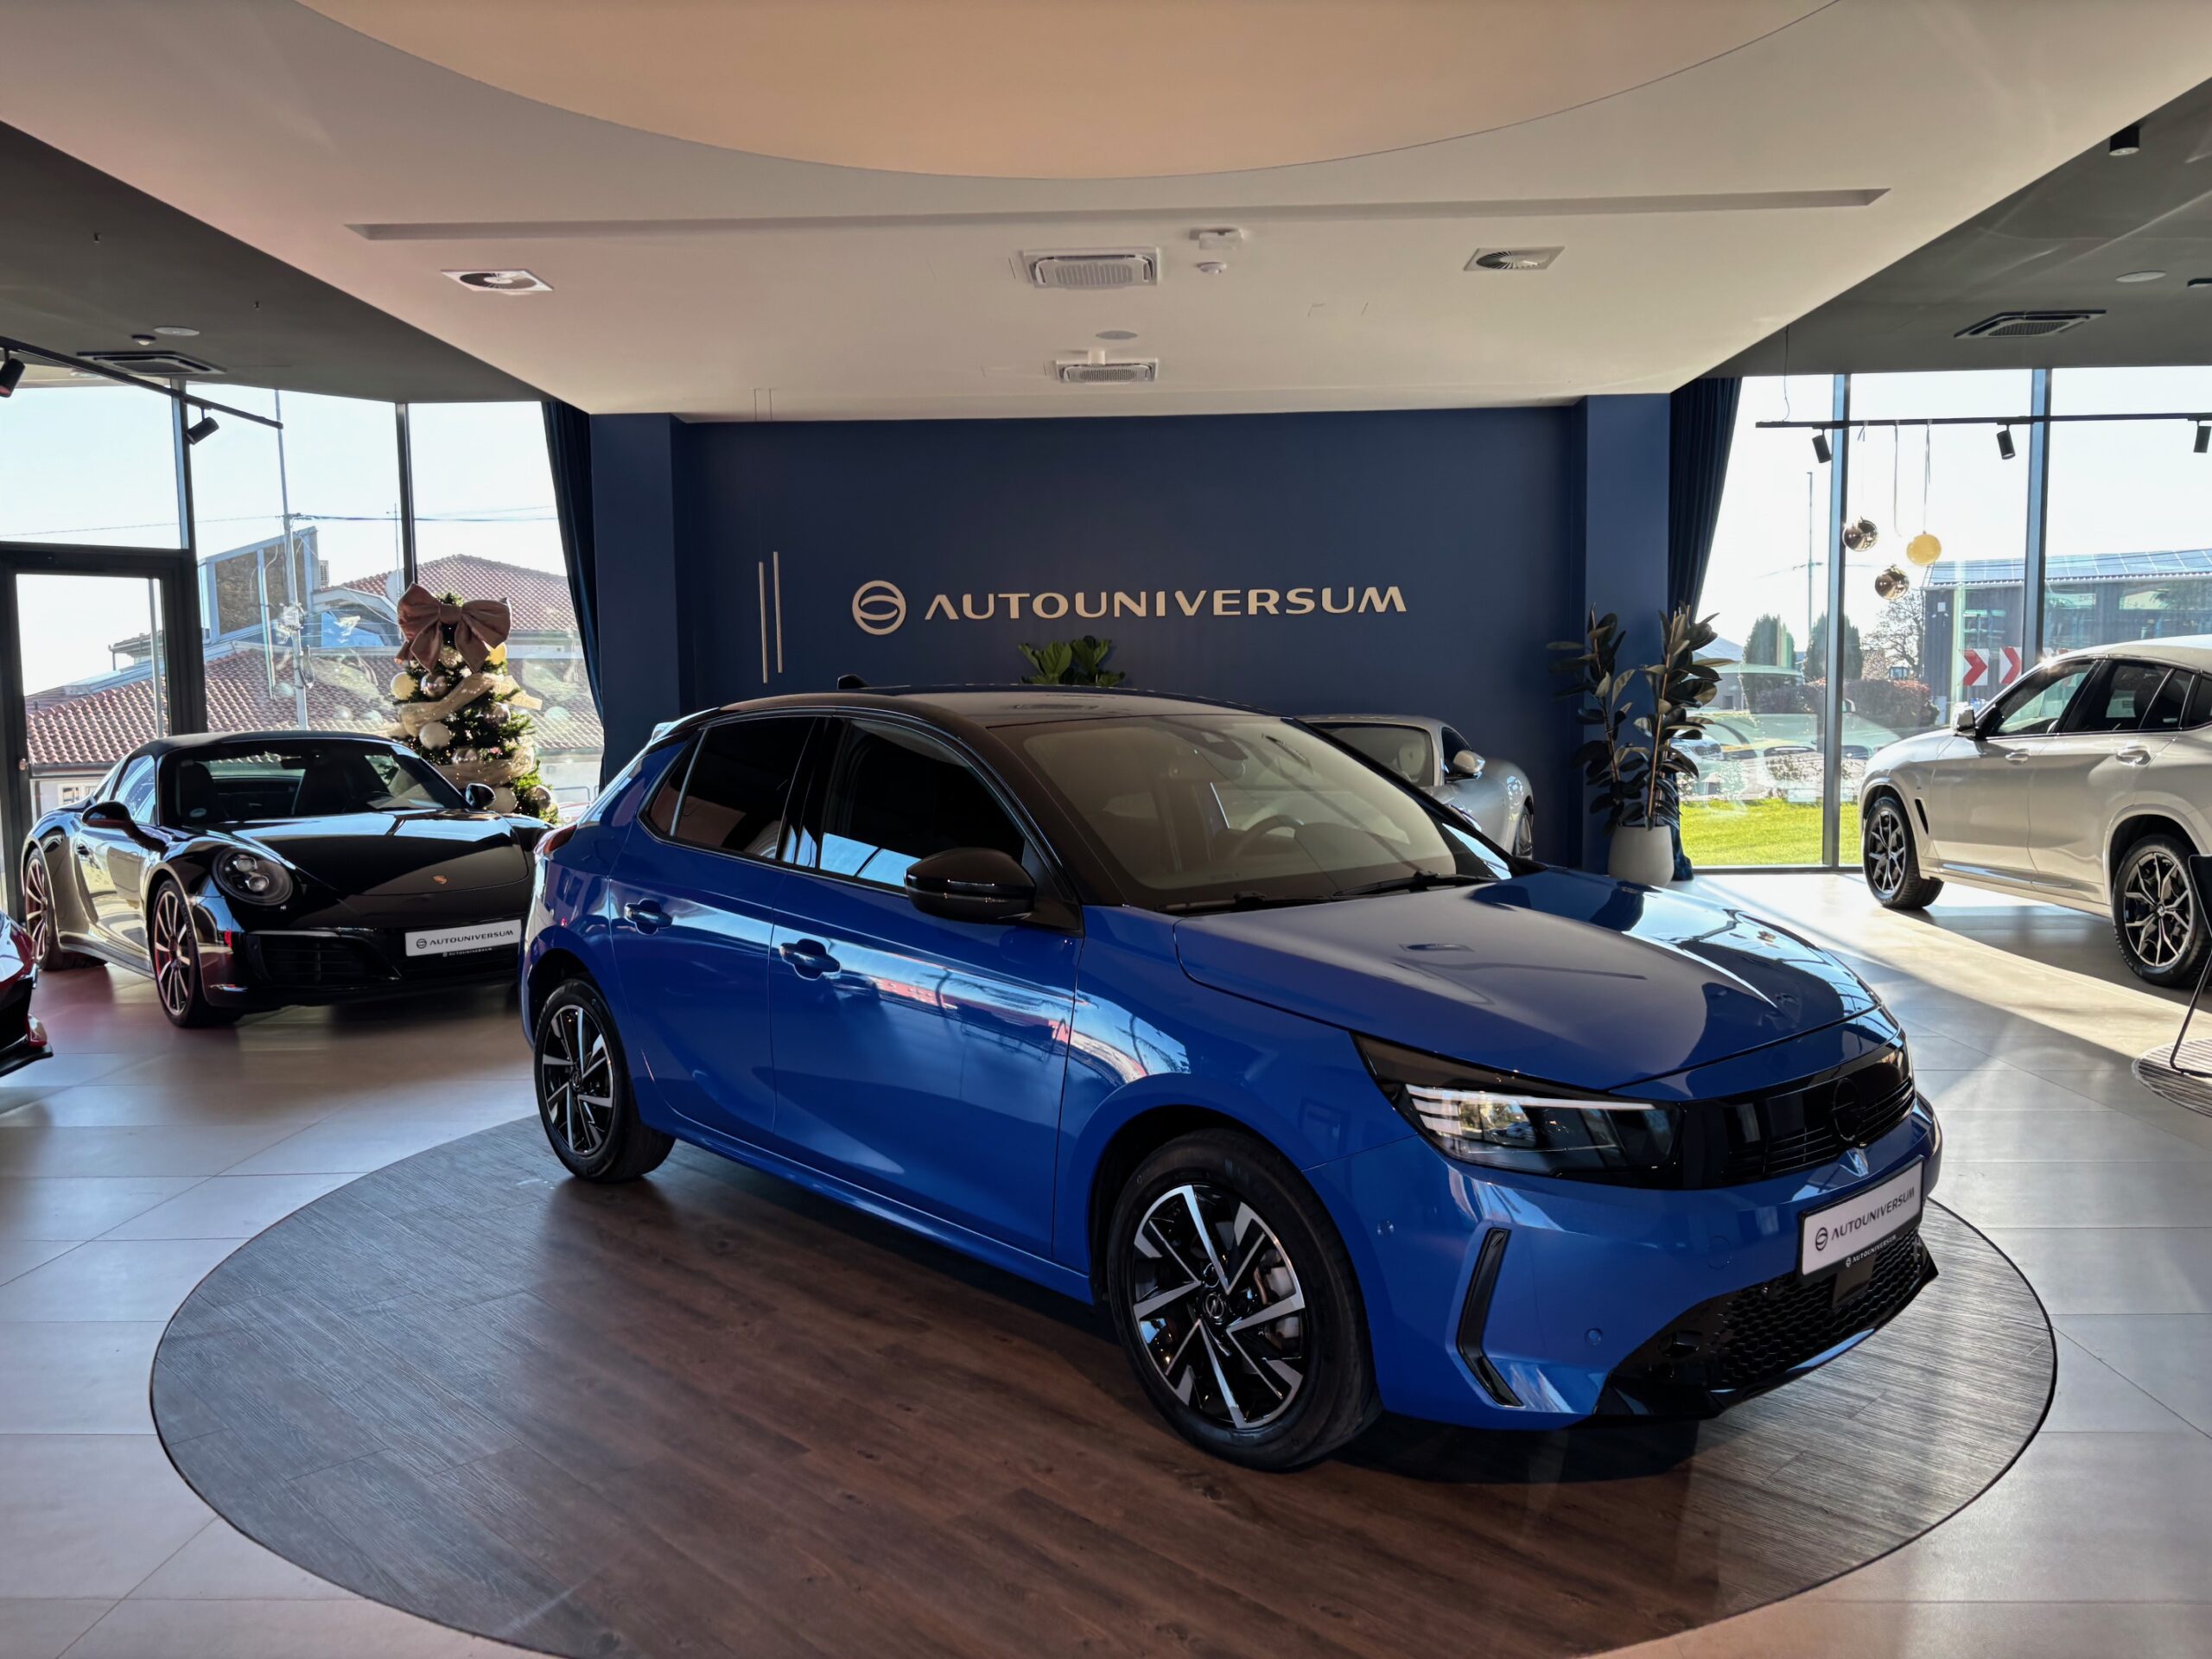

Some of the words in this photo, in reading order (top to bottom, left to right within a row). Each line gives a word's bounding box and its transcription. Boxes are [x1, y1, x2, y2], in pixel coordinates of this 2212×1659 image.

[925, 586, 1407, 620] AUTOUNIVERSUM
[429, 930, 513, 945] AUTOUNIVERSUM
[1831, 1185, 1915, 1240] AUTOUNIVERSUM
[1853, 1234, 1897, 1263] AUTOUNIVERSUM
